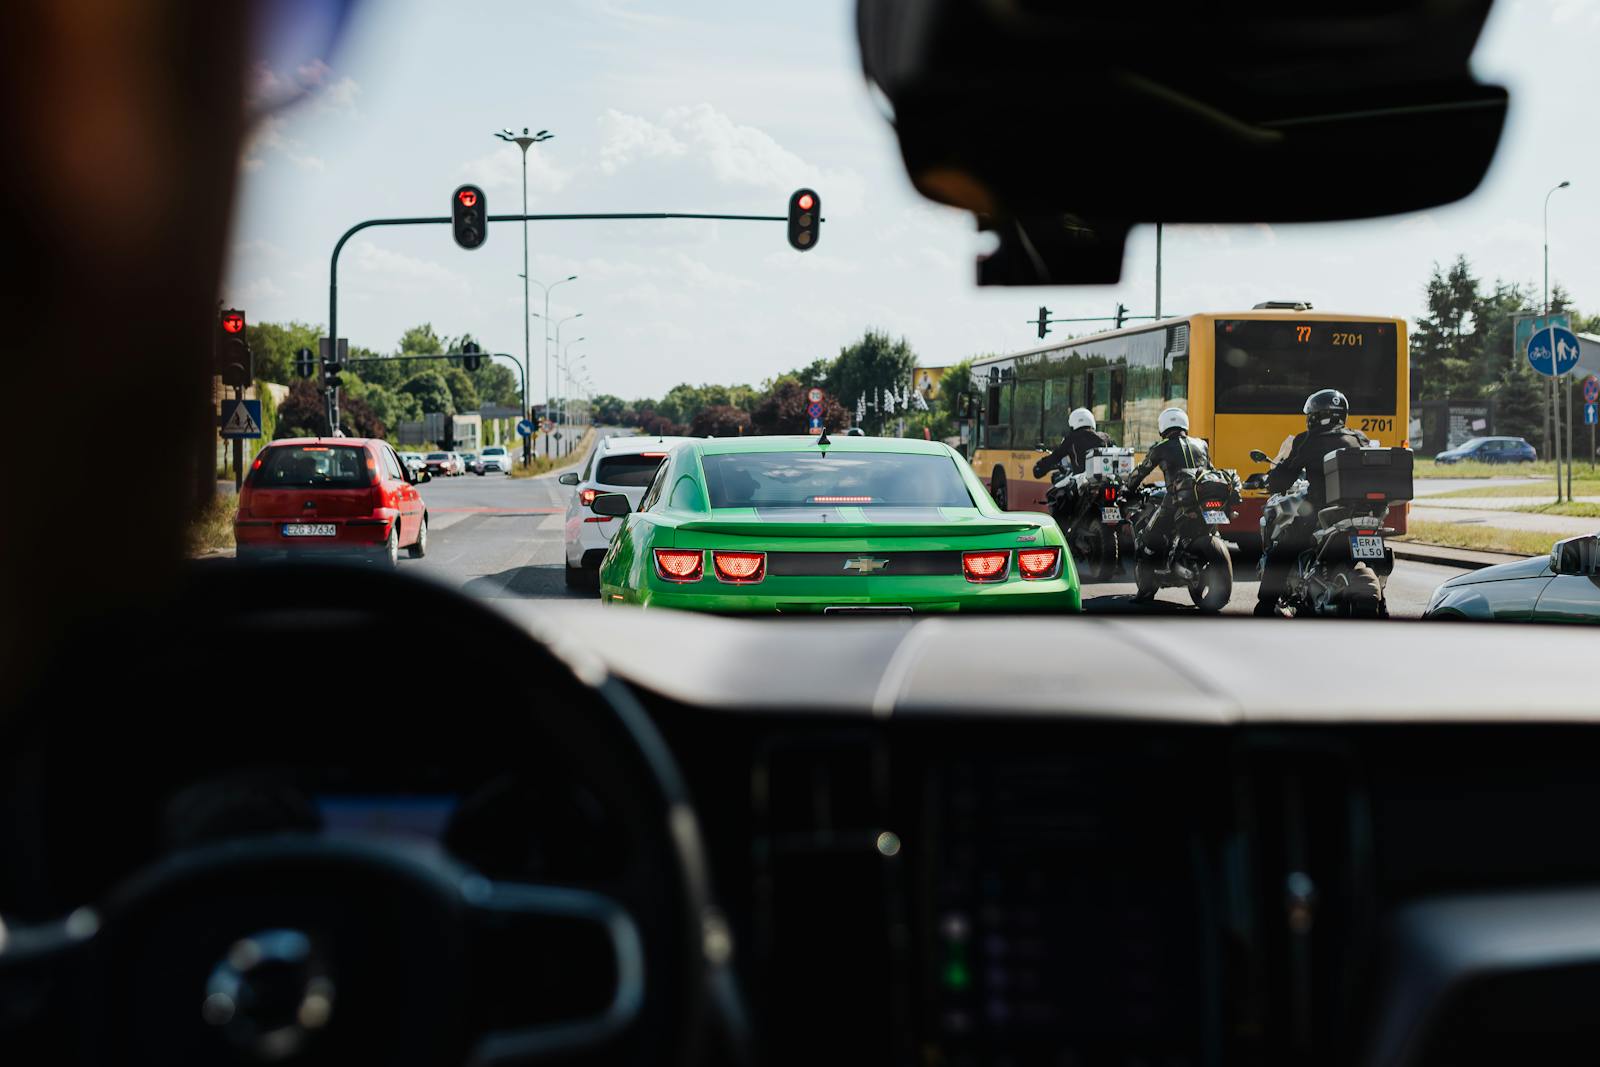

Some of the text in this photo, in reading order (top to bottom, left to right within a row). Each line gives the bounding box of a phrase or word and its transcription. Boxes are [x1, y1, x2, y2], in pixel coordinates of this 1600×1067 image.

[1296, 326, 1311, 342] 77
[1332, 333, 1363, 346] 2701
[1361, 418, 1393, 432] 2701
[1359, 538, 1377, 547] ERA
[1355, 548, 1382, 557] YL50
